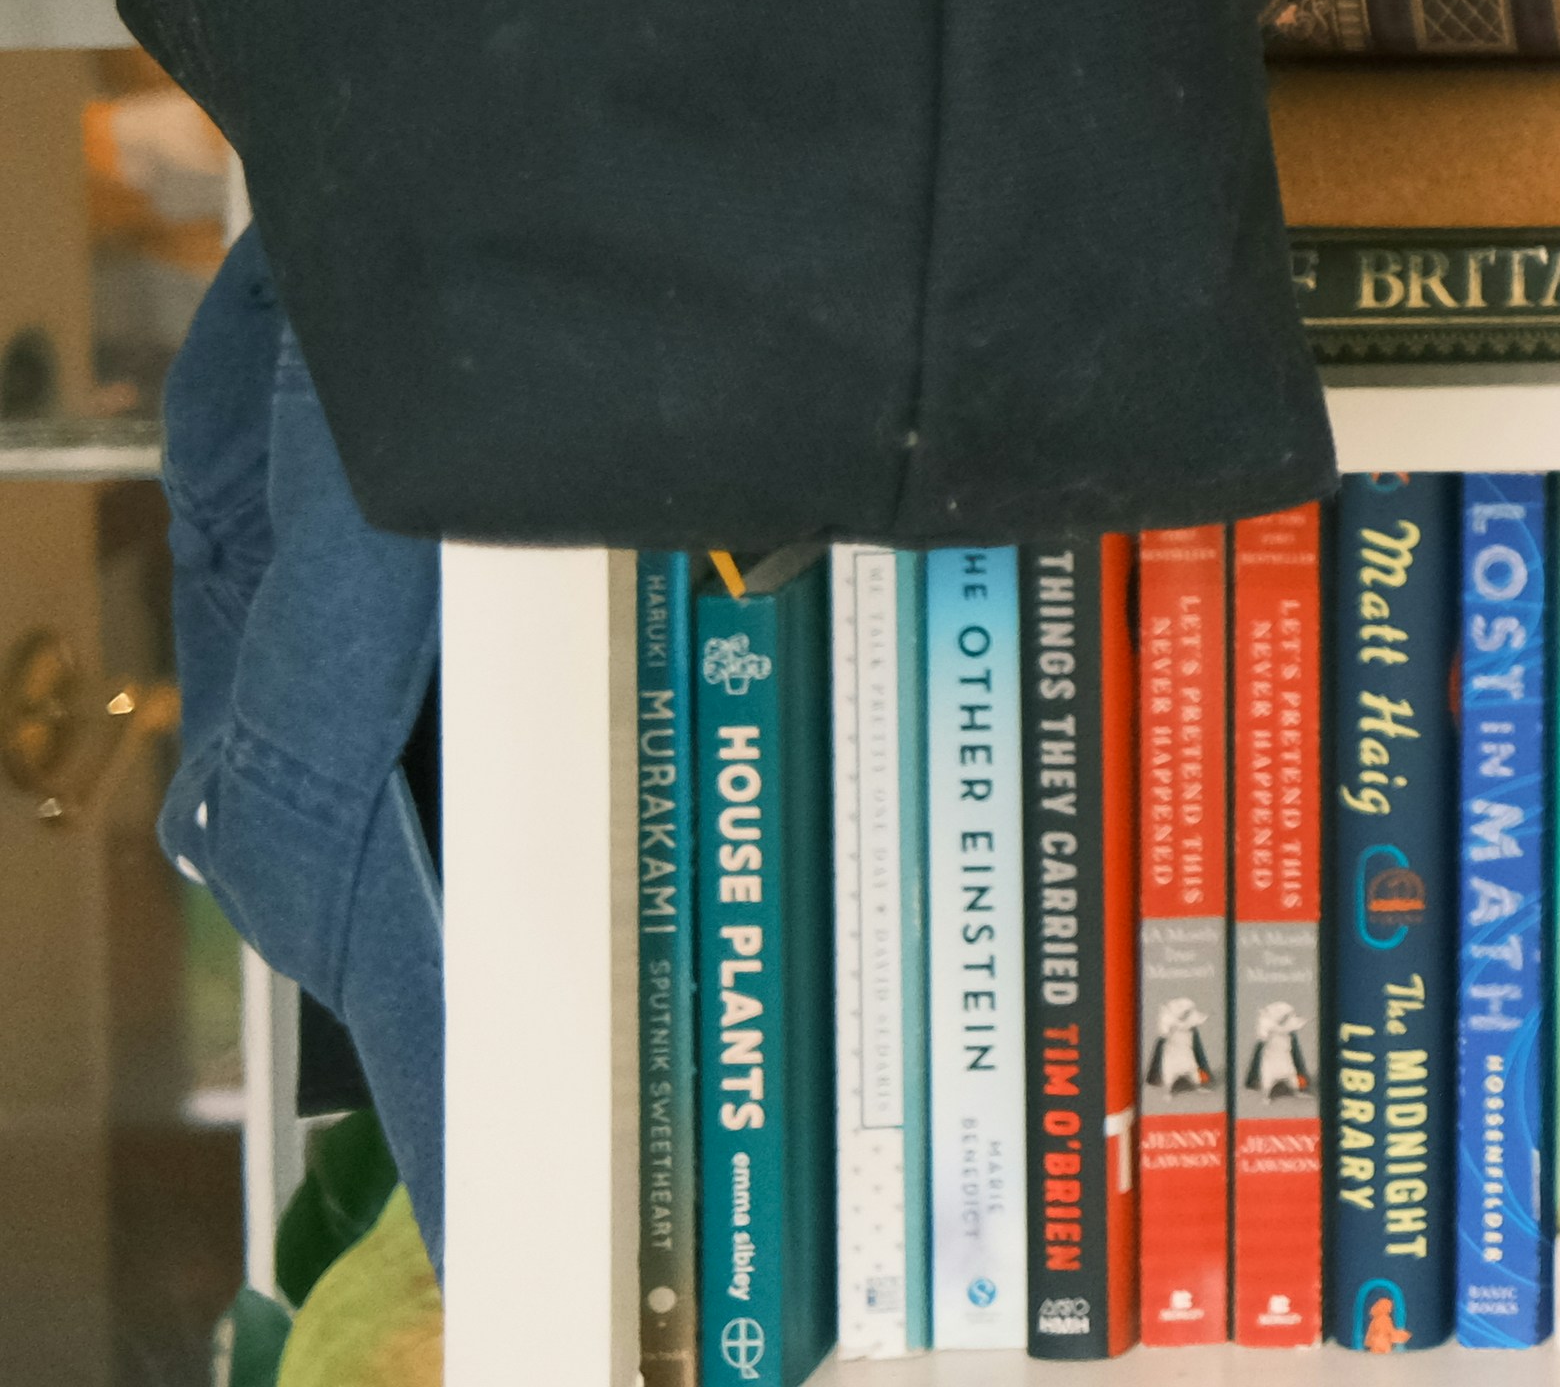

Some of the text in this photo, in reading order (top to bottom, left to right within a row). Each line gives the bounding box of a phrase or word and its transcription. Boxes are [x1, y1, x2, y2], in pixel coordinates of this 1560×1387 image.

[638, 575, 676, 933] HARUKI MURAKAMI
[958, 548, 996, 1073] HE OTHER EINSTEIN
[1039, 553, 1076, 1005] THINGS THEY CARRIED
[1152, 617, 1172, 888] NEVER HAPPENED
[1180, 596, 1203, 904] LET'S PRETEND THIS
[1252, 621, 1273, 890] NEVER HAPPENED
[1280, 600, 1302, 908] LET'S PRETEND THIS
[1342, 522, 1420, 816] Matt Haig
[1469, 503, 1529, 1032] LOST IN MATH
[720, 727, 762, 1132] HOUSE PLANTS
[648, 960, 672, 1250] SPUTNIK SWEETHEART
[728, 1153, 756, 1300] emma sibley
[1043, 1025, 1082, 1270] TIM O'BRIEN
[1339, 1024, 1375, 1209] LIBRARY
[1386, 975, 1427, 1257] The MIDNIGHT
[1484, 1056, 1505, 1262] HOSSENFELDER
